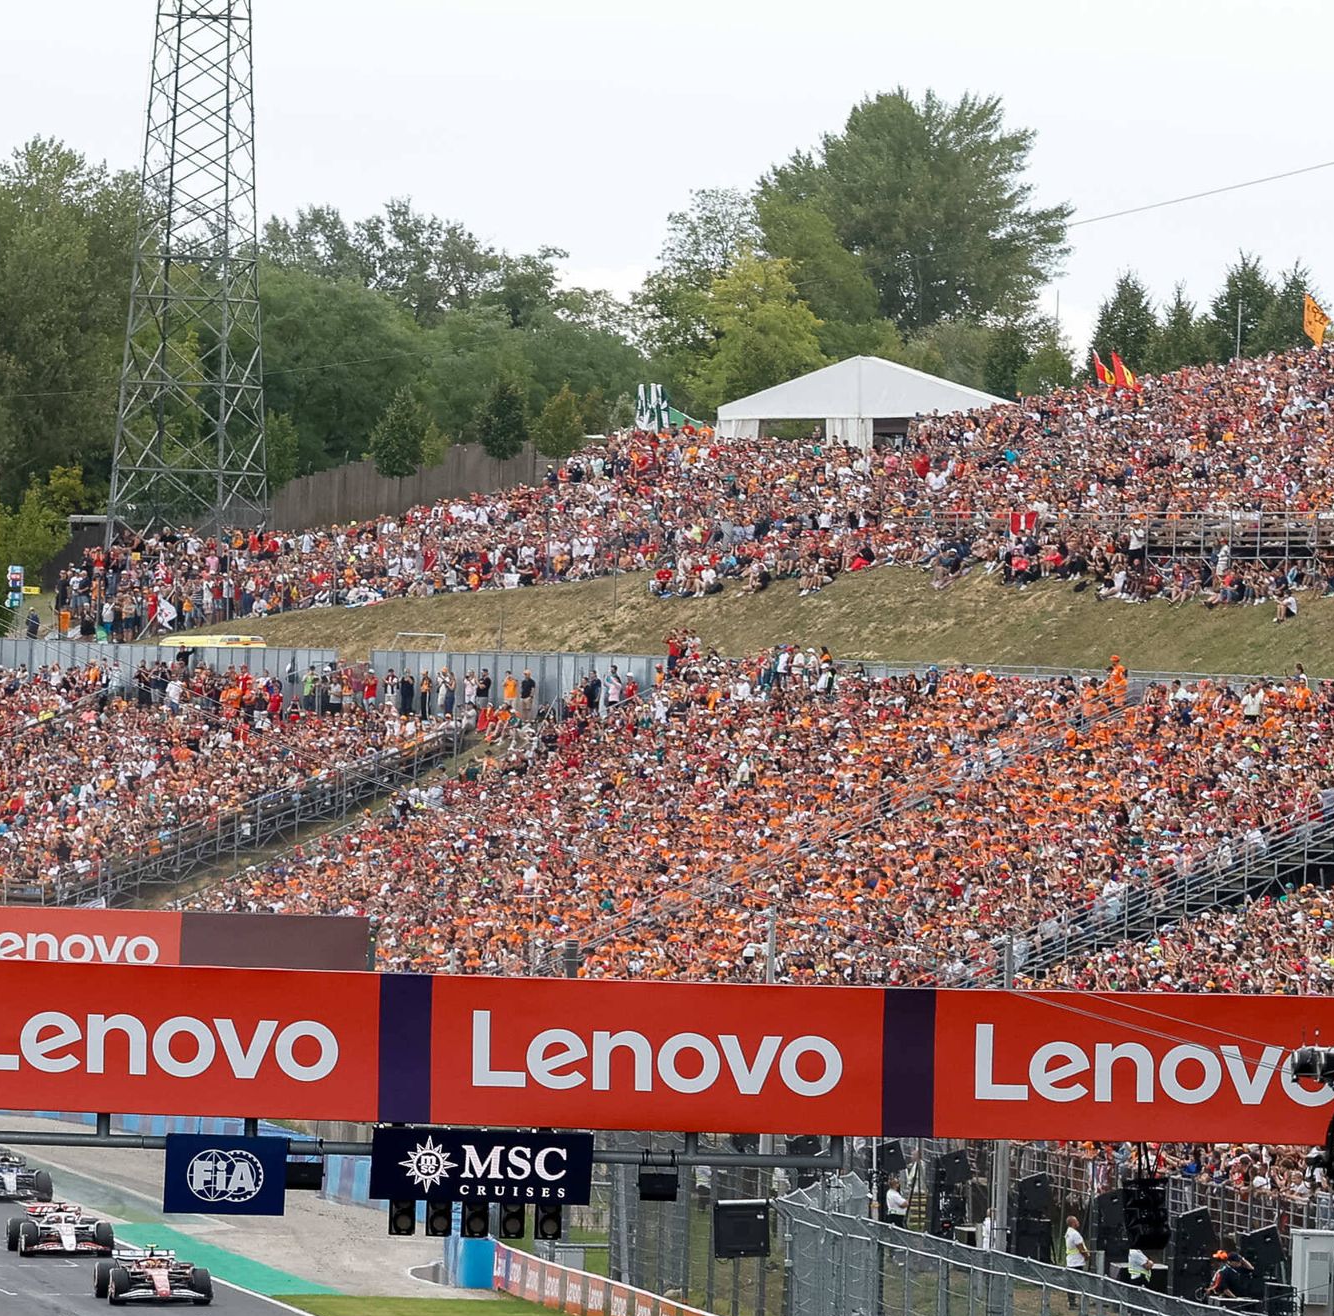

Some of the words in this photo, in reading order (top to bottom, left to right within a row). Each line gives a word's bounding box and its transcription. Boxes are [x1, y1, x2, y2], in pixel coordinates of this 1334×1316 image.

[473, 1009, 843, 1096] Lenovo
[460, 1145, 567, 1181] MSC
[459, 1185, 566, 1198] CRUISES
